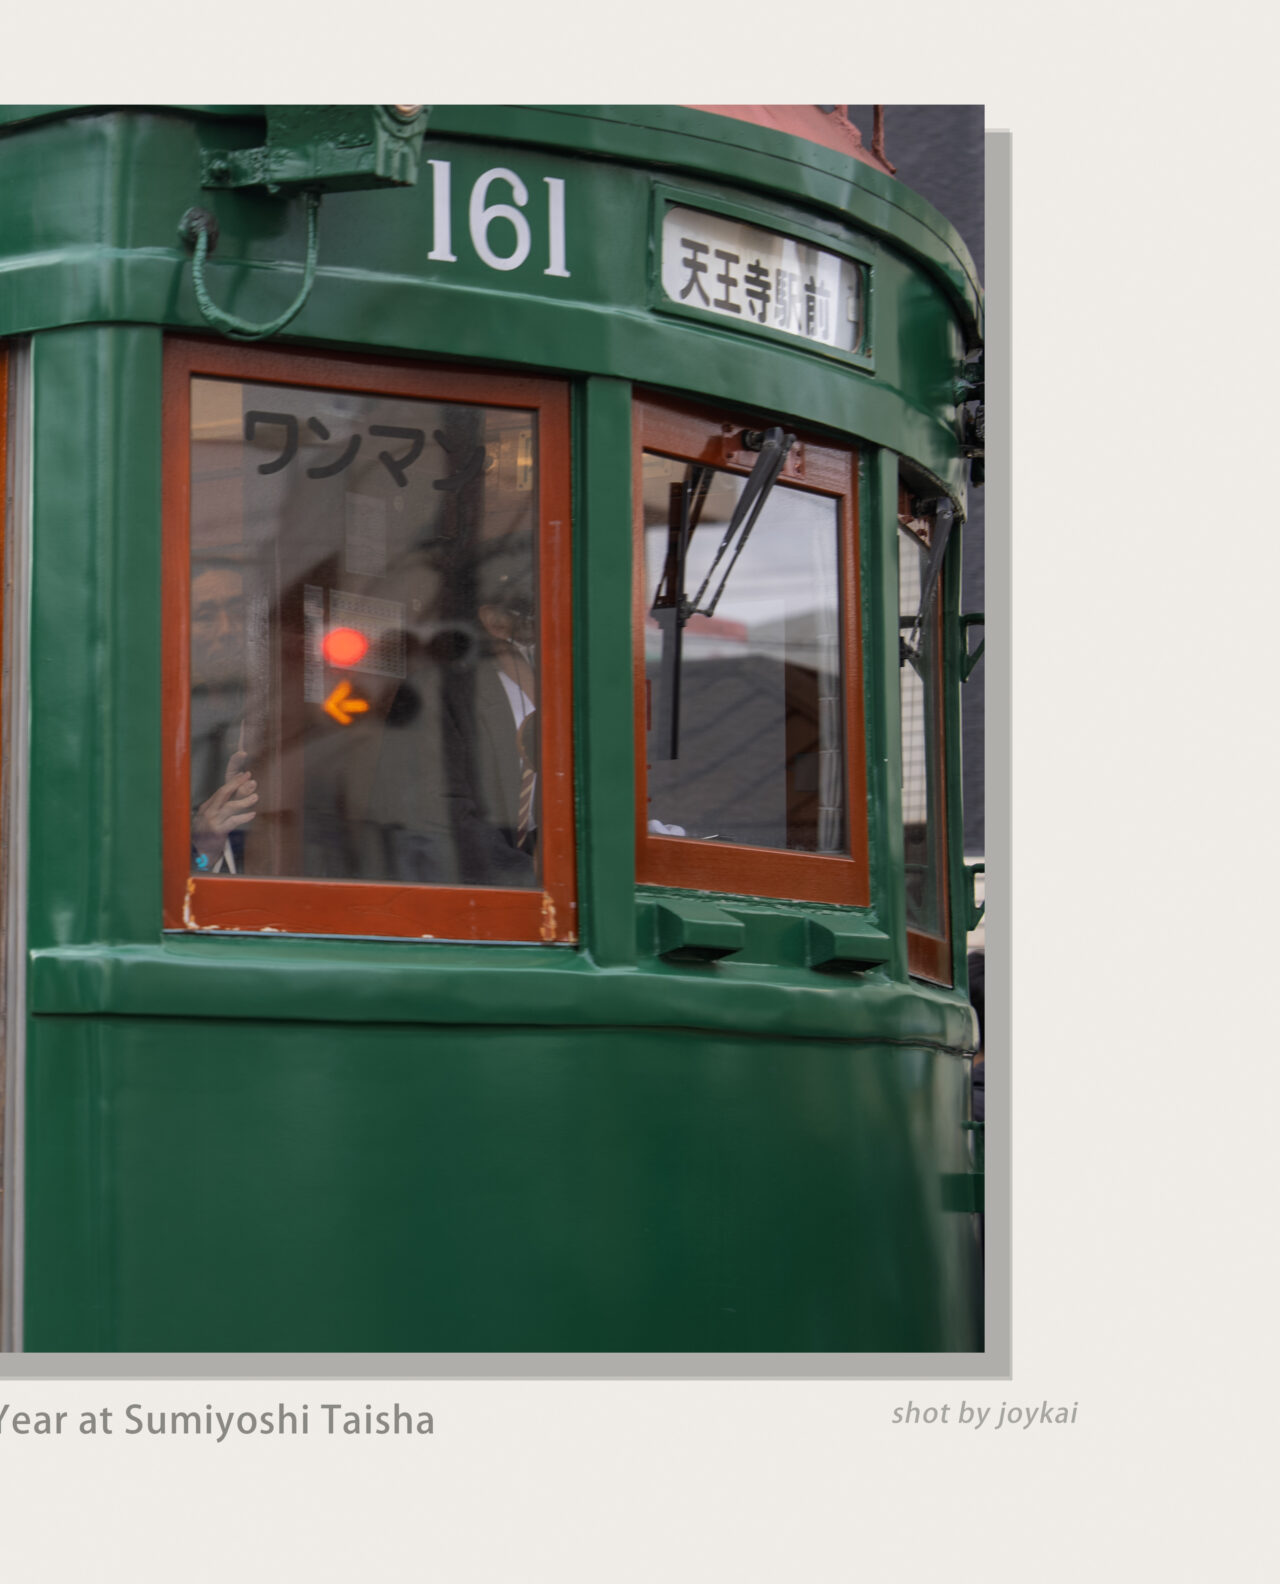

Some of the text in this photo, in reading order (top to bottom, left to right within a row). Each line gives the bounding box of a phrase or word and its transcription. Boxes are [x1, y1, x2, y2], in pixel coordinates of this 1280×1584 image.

[426, 159, 571, 278] 161
[679, 237, 831, 340] 天王寺駅前
[245, 410, 486, 491] ワンマン
